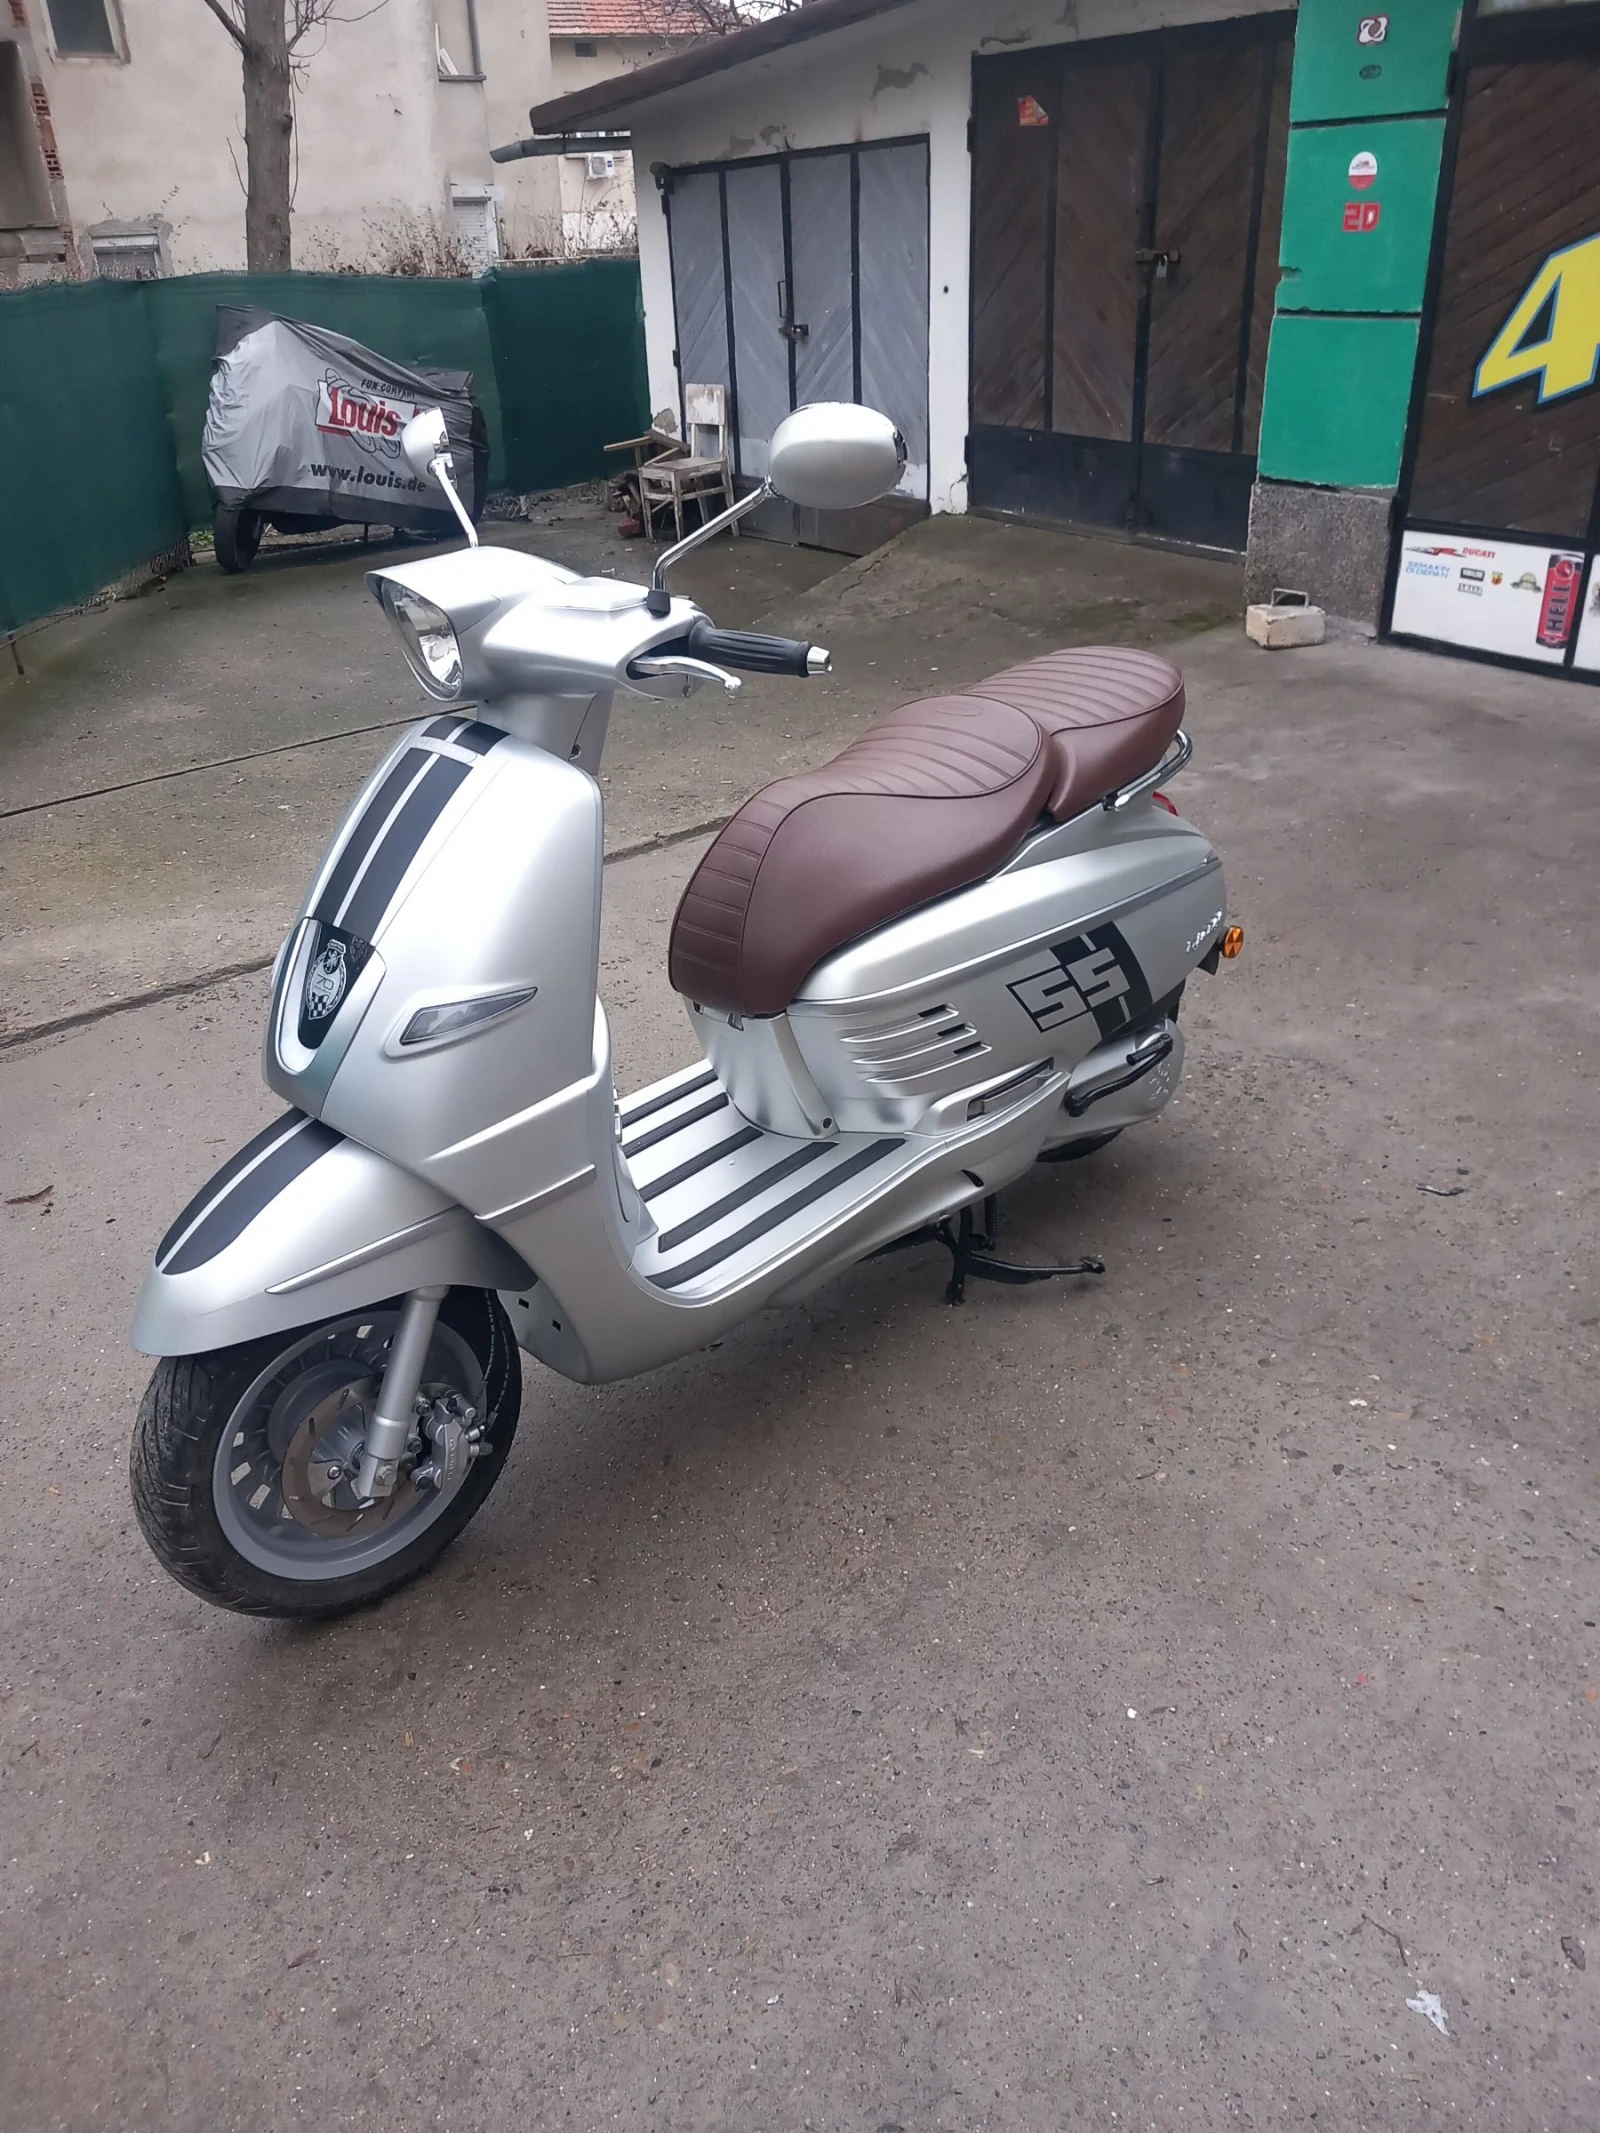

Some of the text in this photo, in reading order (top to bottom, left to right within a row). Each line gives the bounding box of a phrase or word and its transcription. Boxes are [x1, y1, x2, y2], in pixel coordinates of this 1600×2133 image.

[361, 379, 378, 391] FUN
[329, 387, 401, 436] Louis
[310, 463, 426, 491] www.louis.de
[1462, 547, 1496, 559] DUCATI
[1546, 584, 1571, 633] HELL
